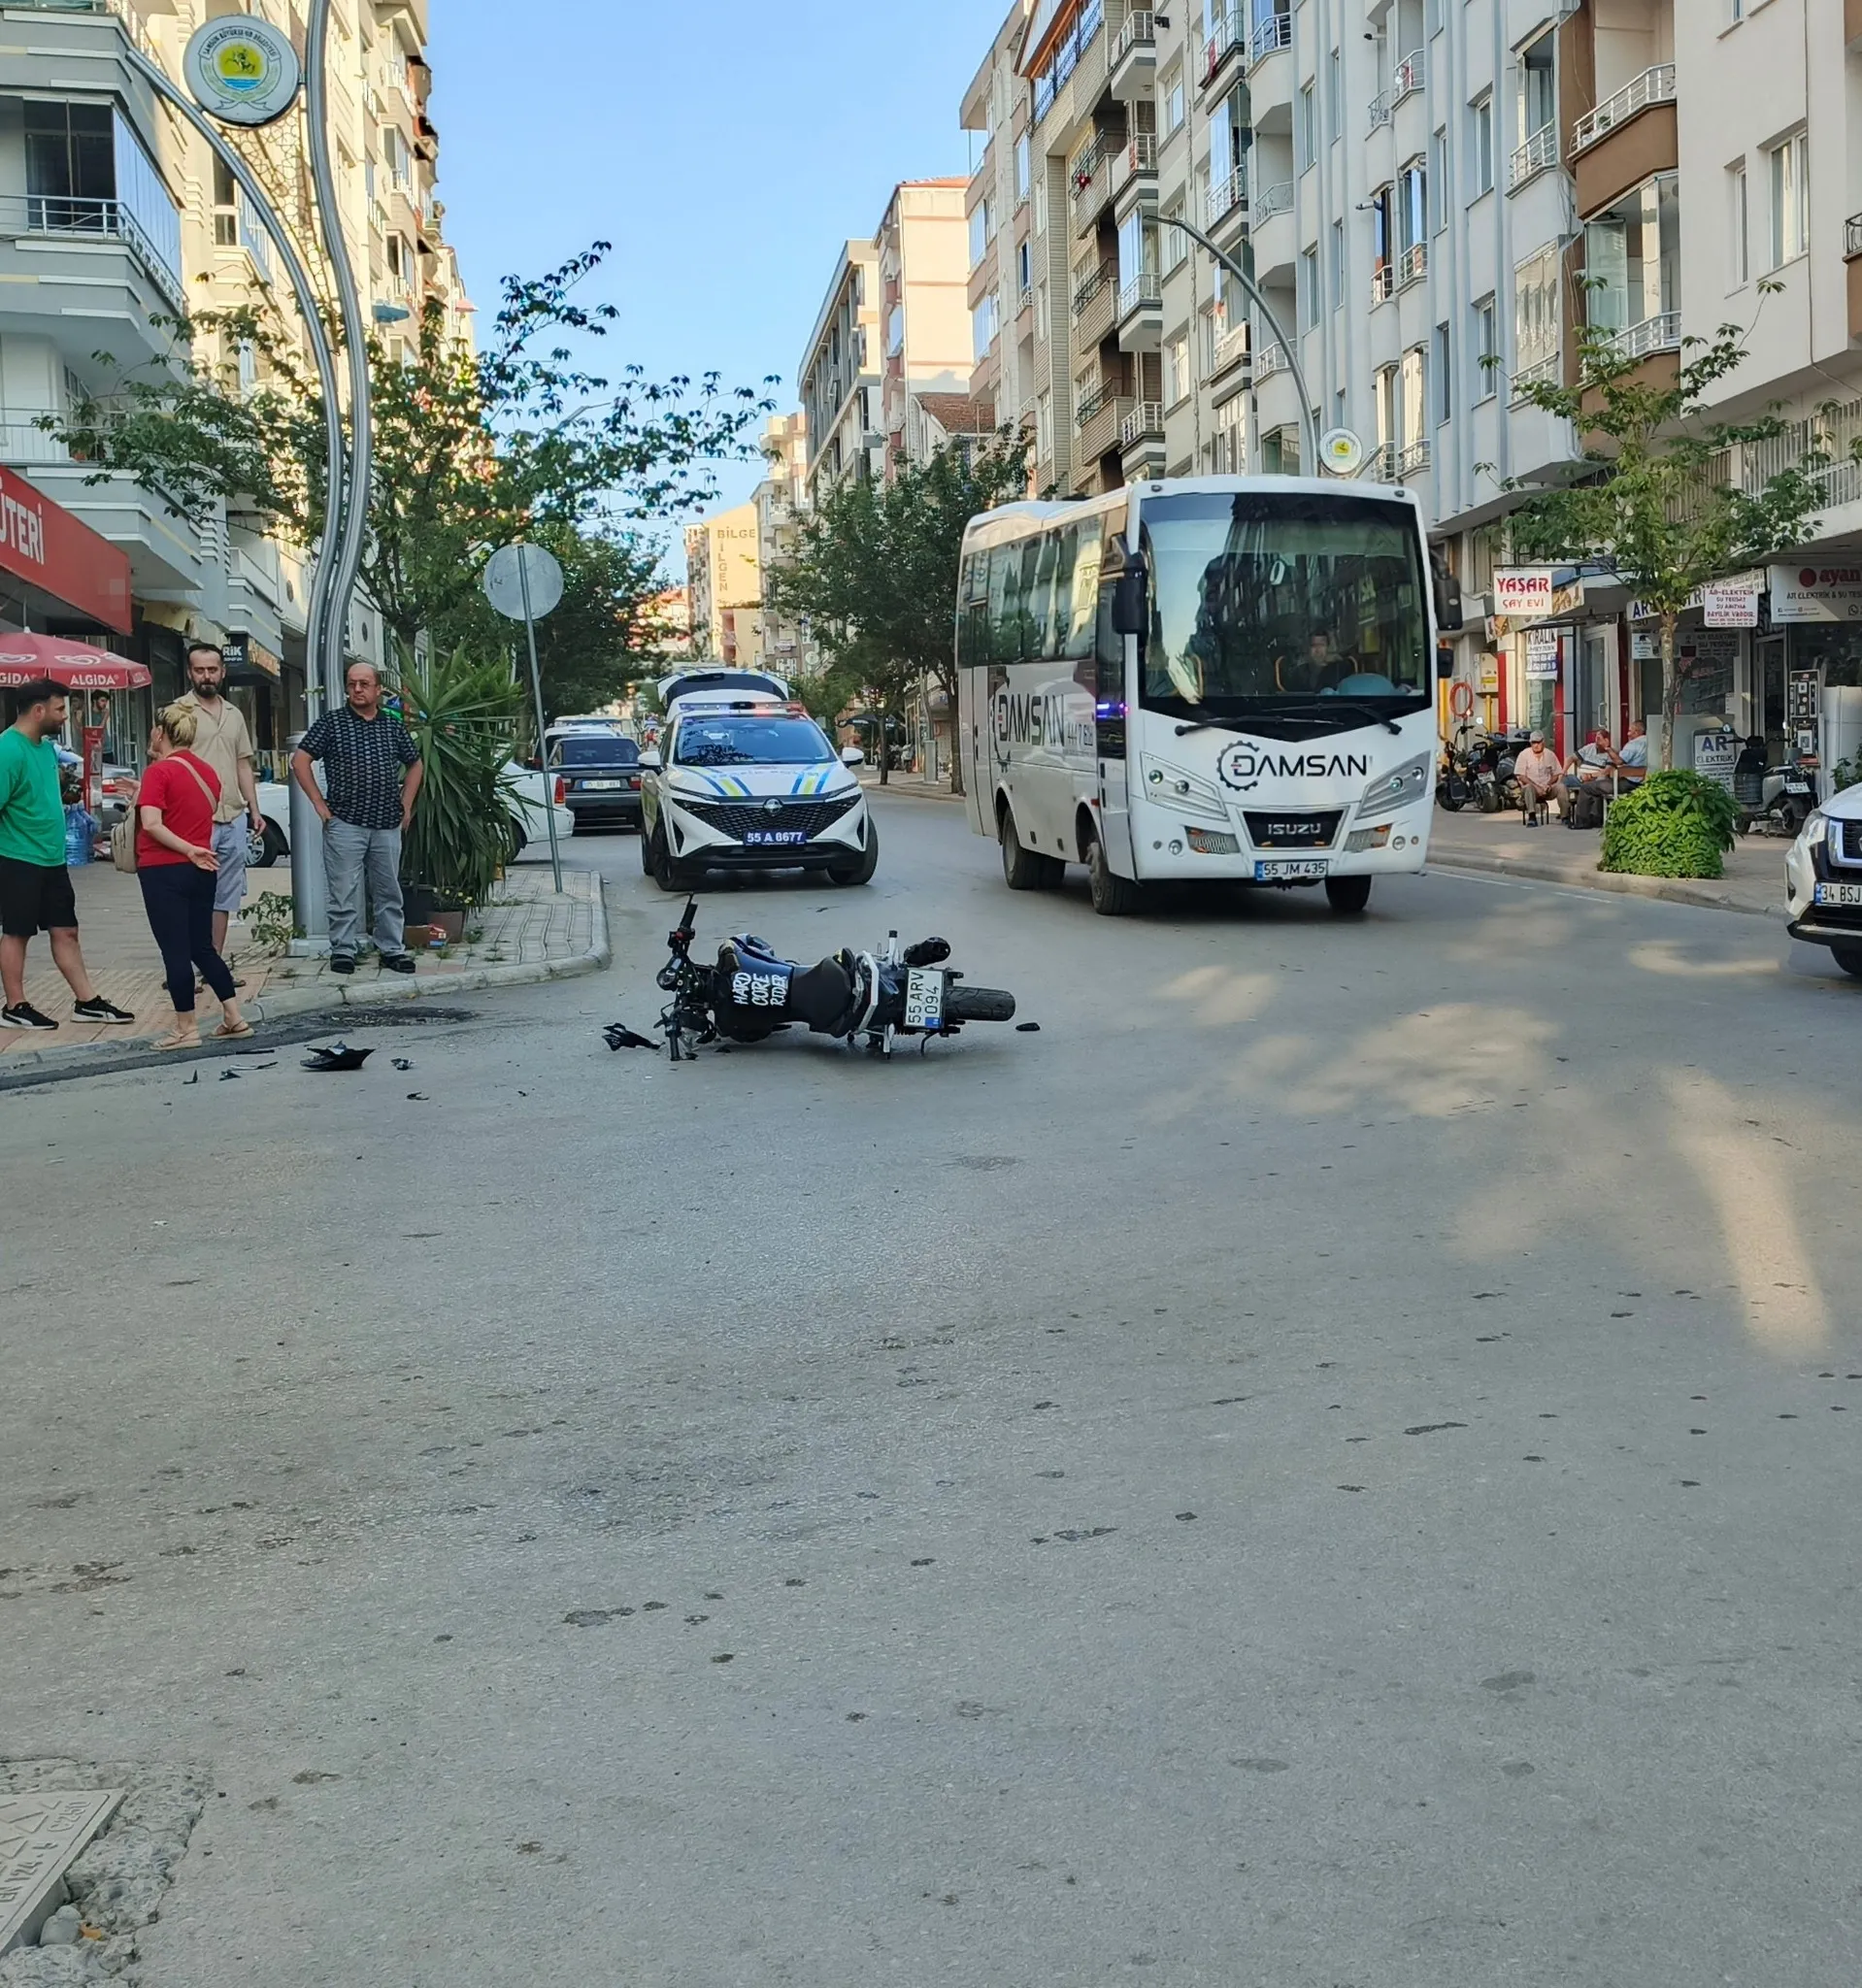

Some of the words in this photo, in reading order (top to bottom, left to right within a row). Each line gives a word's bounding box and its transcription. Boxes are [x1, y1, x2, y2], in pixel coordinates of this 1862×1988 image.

[1496, 577, 1550, 595] YAŞAR
[1502, 598, 1523, 609] ÇAY
[70, 675, 116, 685] ALGIDA
[997, 693, 1065, 746] DAMSAN
[1702, 736, 1728, 751] AR
[1231, 754, 1367, 777] DAMSAN
[747, 832, 761, 843] 55
[764, 832, 774, 843] A
[1268, 823, 1321, 835] ISUZU
[1264, 863, 1279, 876] 55
[1282, 863, 1300, 875] JM
[1304, 862, 1325, 875] 435
[1820, 885, 1835, 900] 34
[733, 972, 752, 1006] HARD
[750, 973, 770, 1007] CORE
[770, 974, 789, 1008] RIDER
[909, 971, 924, 1004] ARV
[924, 985, 940, 1014] 094
[909, 1004, 922, 1024] 55
